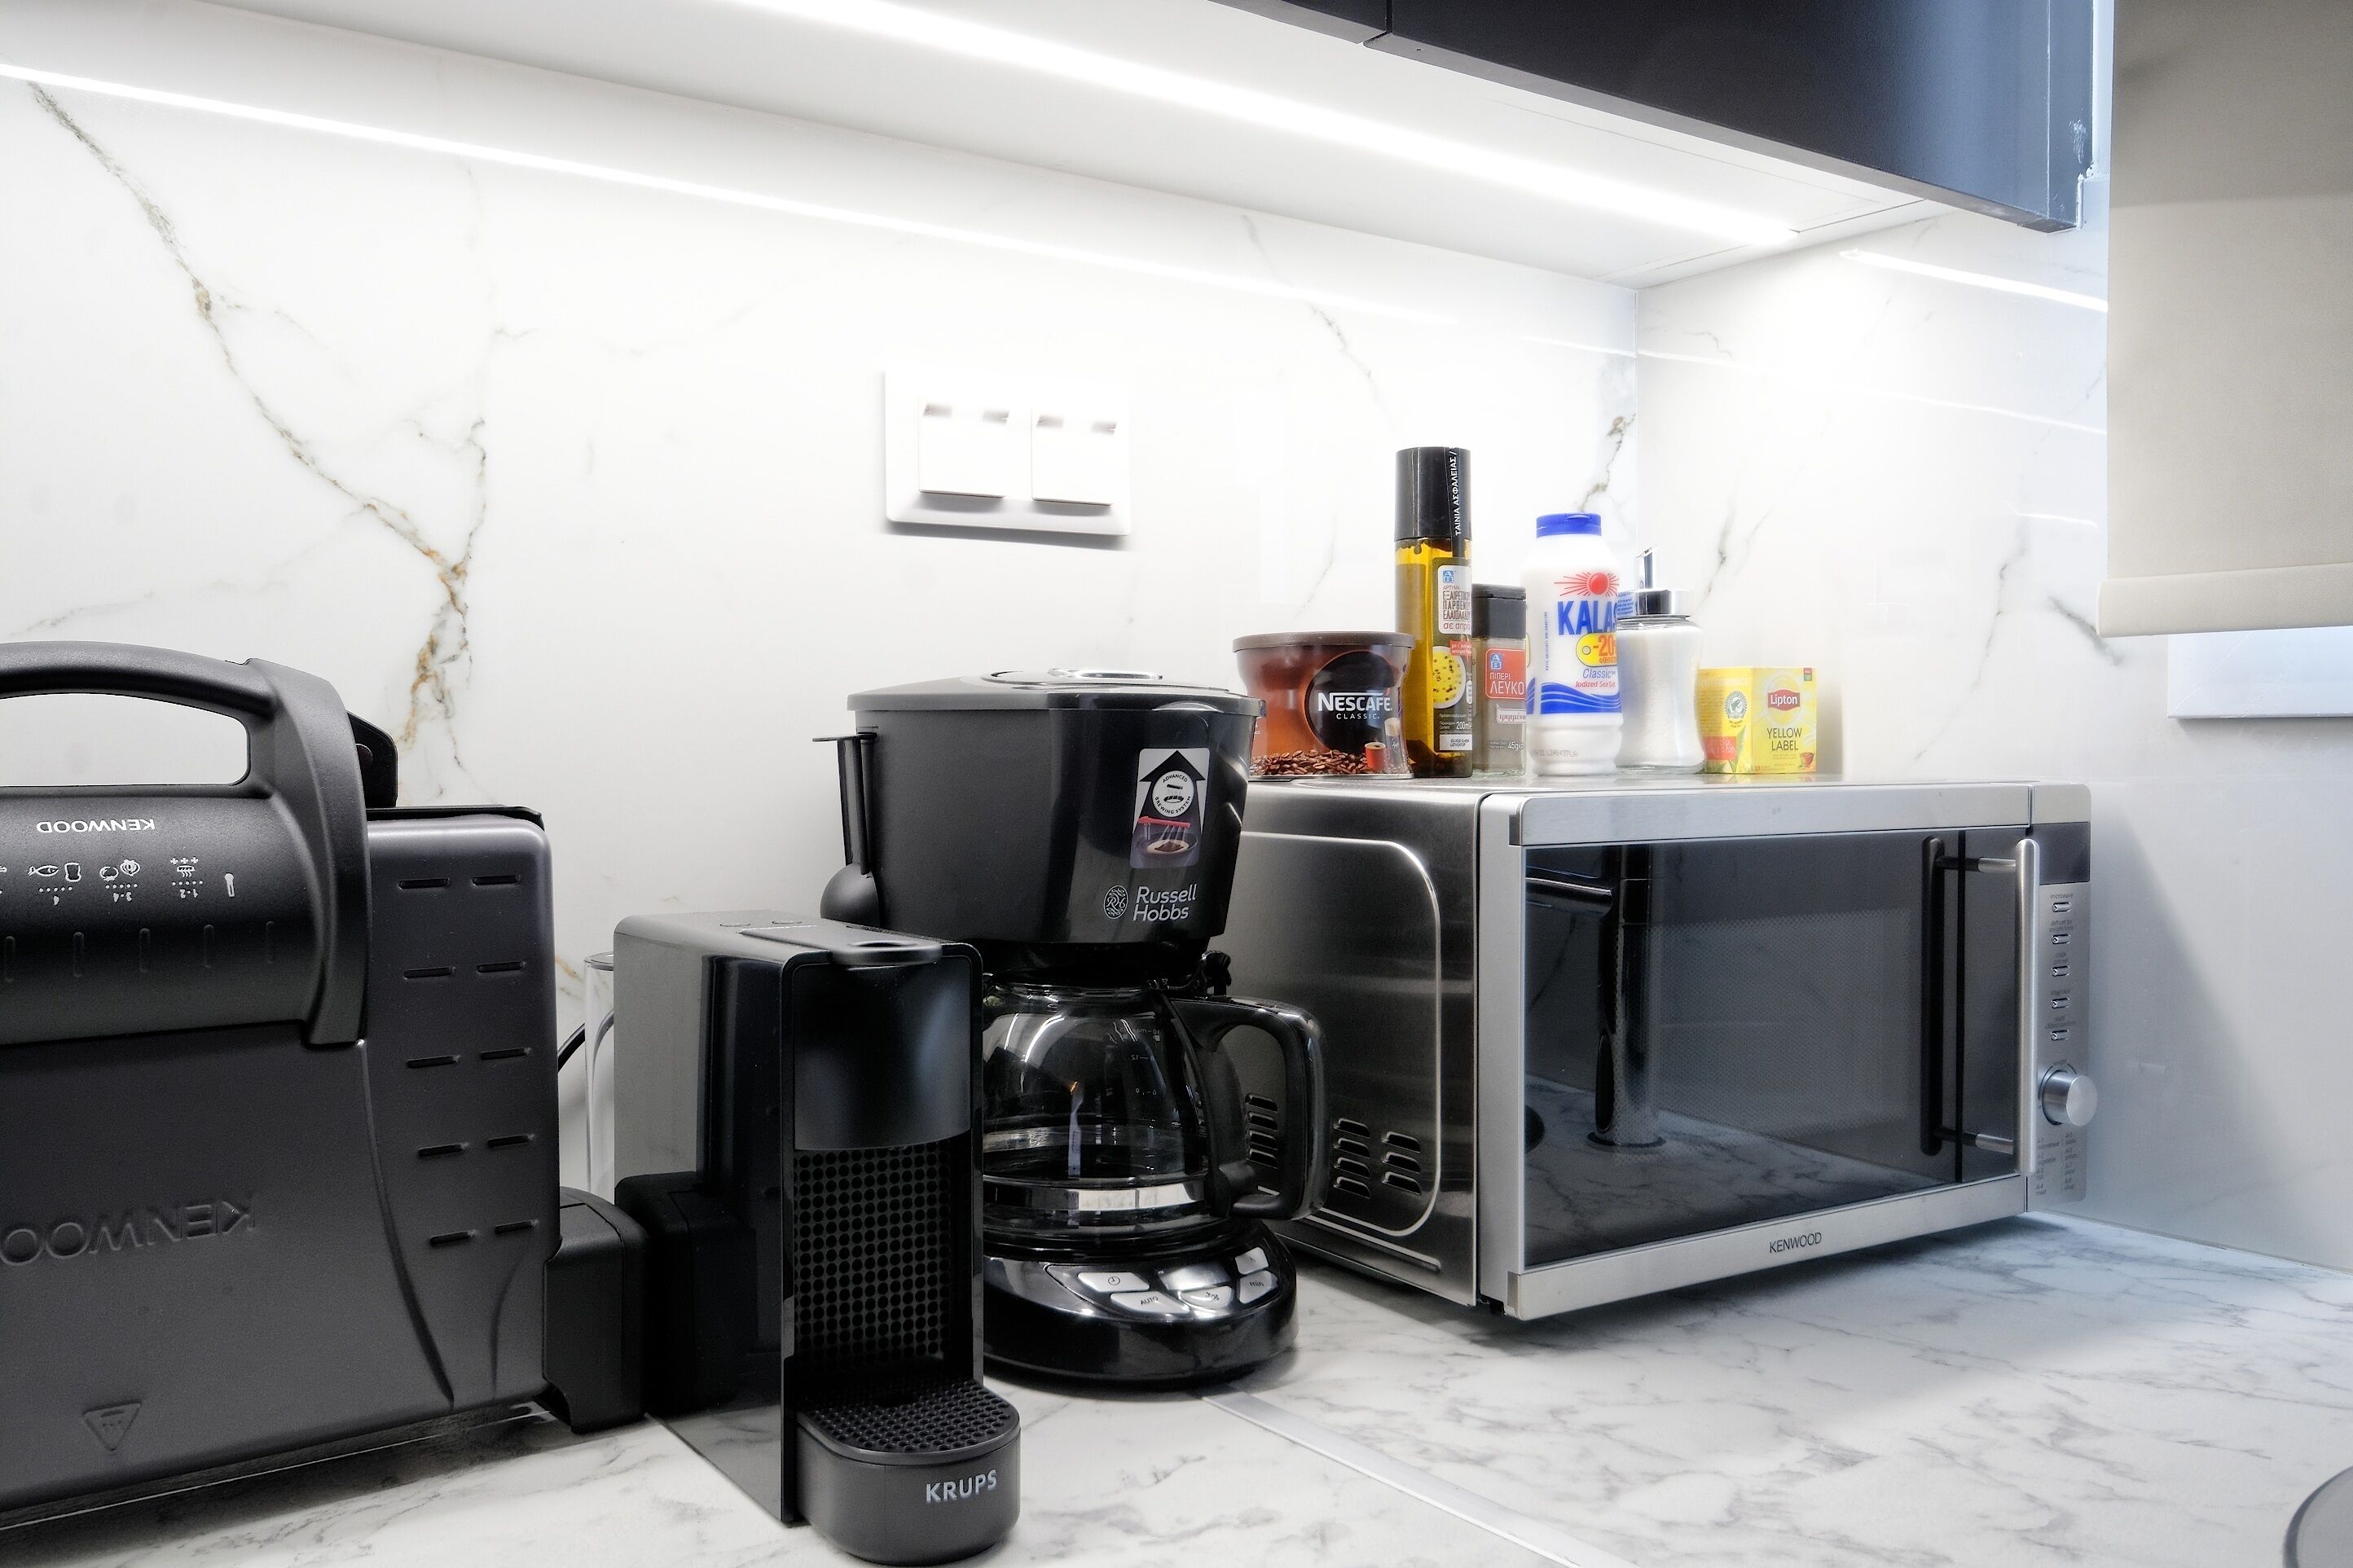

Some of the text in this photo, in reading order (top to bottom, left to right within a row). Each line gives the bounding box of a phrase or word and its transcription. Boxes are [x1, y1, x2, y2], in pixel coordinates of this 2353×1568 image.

[1449, 456, 1459, 507] ΑΣΦΑΛΕΙΑΣ
[1453, 508, 1462, 536] ΤΑΙΝΙΑ
[1442, 591, 1470, 600] ΕΞΑΙΡΕΤΙΚΟ
[1443, 600, 1470, 610] ΠΑΡΘΕΝΟ
[1489, 672, 1511, 680] ΠΙΠΕΡΙ
[1582, 668, 1612, 679] Classic
[1489, 681, 1524, 695] ΛΕΥΚΟ
[1770, 694, 1798, 708] Lipton
[1766, 727, 1803, 738] YELLOW
[1771, 740, 1799, 751] LABEL
[1162, 774, 1189, 784] ADVANCED
[1155, 795, 1191, 815] BREWING SYSTEM
[37, 818, 156, 833] KENWOOD
[1136, 884, 1198, 905] Russell
[1133, 905, 1190, 922] Hobbs
[0, 1194, 256, 1267] KENWOO
[1769, 1232, 1823, 1254] KENWOOD
[1249, 1280, 1264, 1288] min
[1140, 1295, 1159, 1306] AUTO
[926, 1469, 998, 1504] KRUPS
